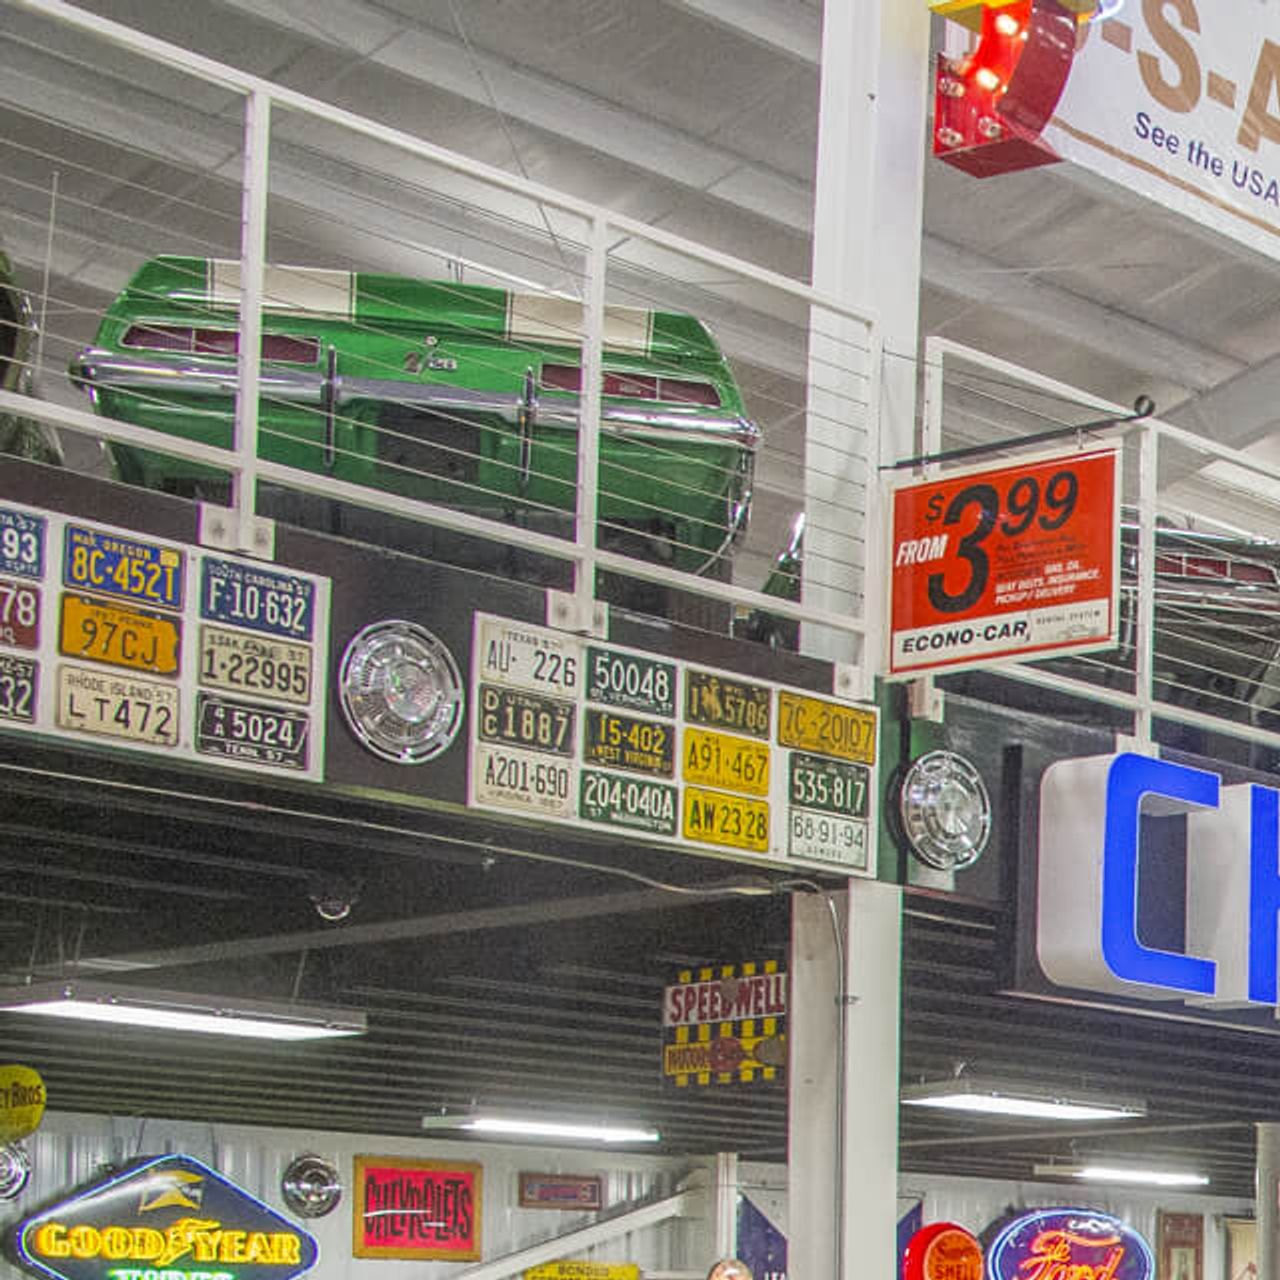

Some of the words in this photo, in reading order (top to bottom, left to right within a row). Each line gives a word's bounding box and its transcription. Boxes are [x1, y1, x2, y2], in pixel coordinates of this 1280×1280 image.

[1134, 112, 1179, 155] See
[1187, 142, 1224, 177] the
[1232, 165, 1280, 207] USA
[896, 533, 949, 568] FROM
[902, 621, 1028, 653] ECONO-CAR
[533, 649, 577, 690] 226
[593, 652, 670, 702] 50048
[233, 711, 294, 747] 5024
[503, 709, 569, 747] 1887
[36, 1220, 300, 1265] GOODYEAR
[558, 1265, 609, 1277] BONDED
[935, 1264, 977, 1280] SHELL
